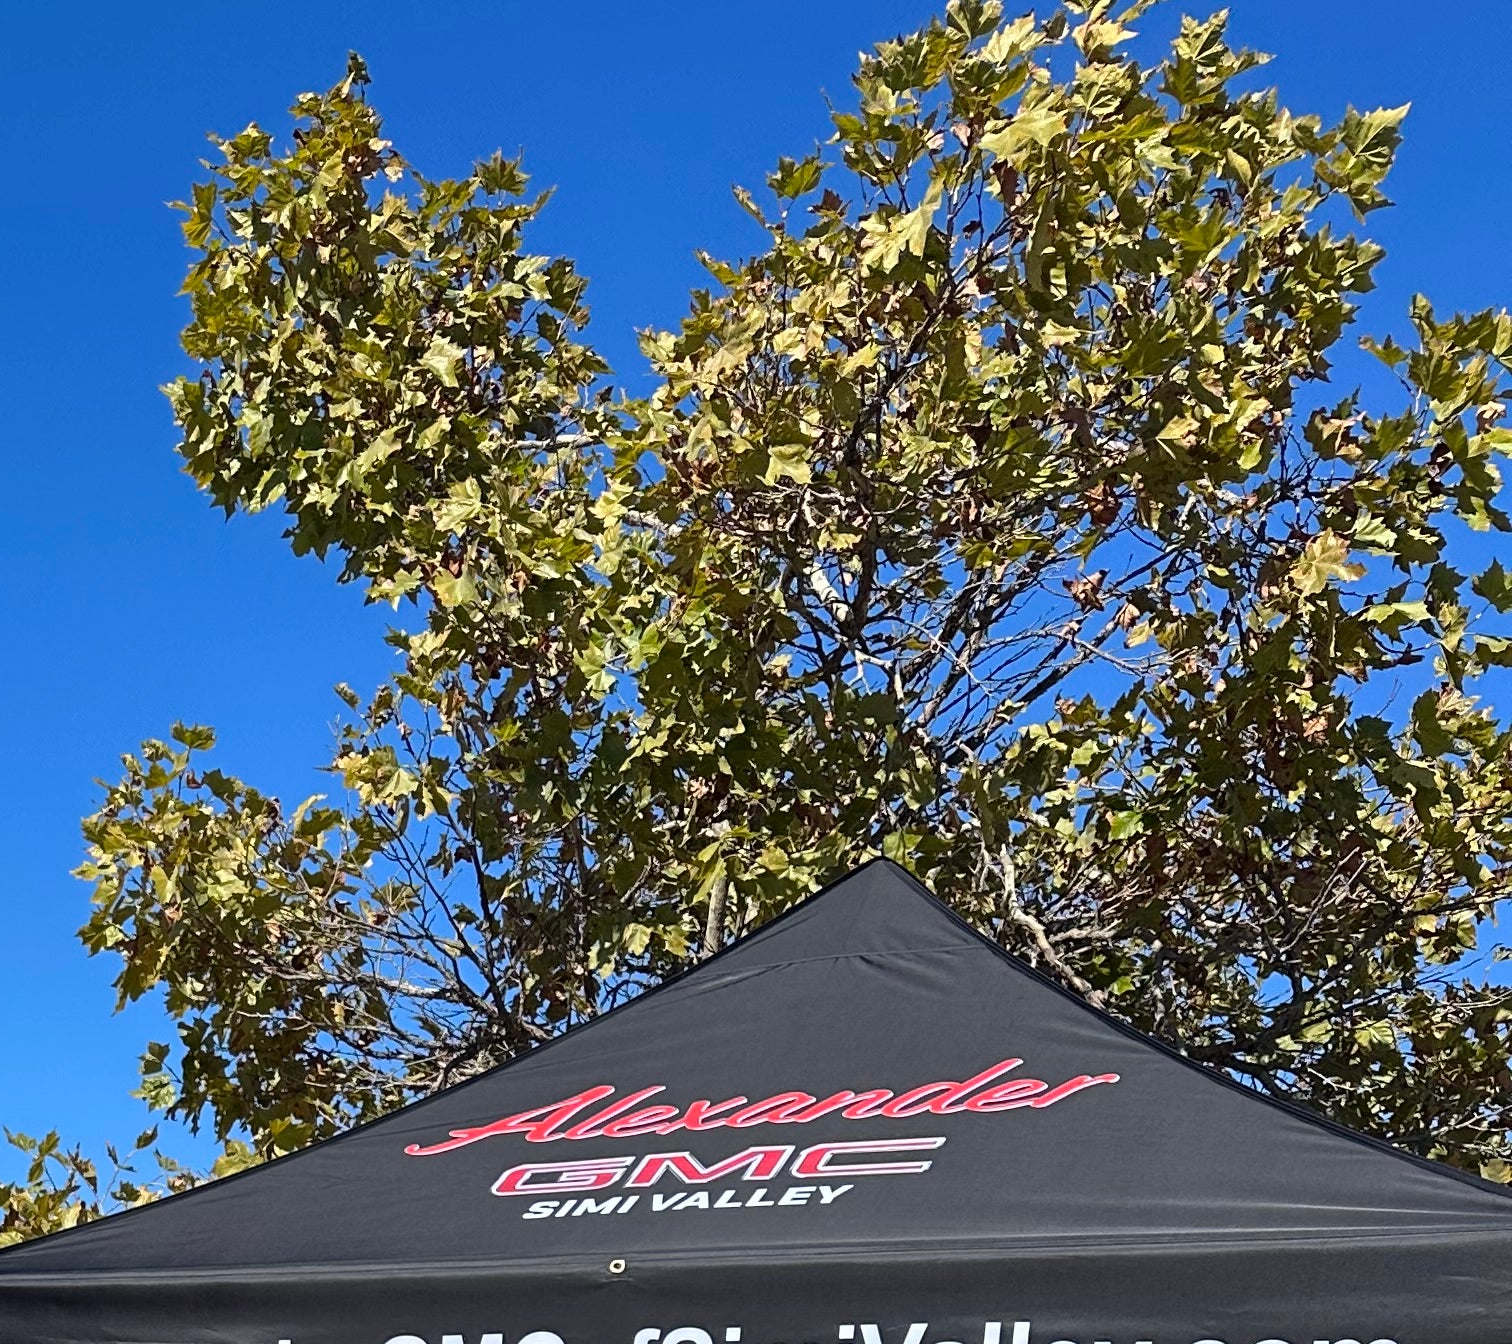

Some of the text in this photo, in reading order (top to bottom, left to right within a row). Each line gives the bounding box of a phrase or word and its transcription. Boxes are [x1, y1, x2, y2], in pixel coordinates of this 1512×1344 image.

[404, 1058, 1121, 1157] Alexander
[490, 1137, 947, 1198] GMC
[521, 1183, 855, 1220] SIMI VALLEY
